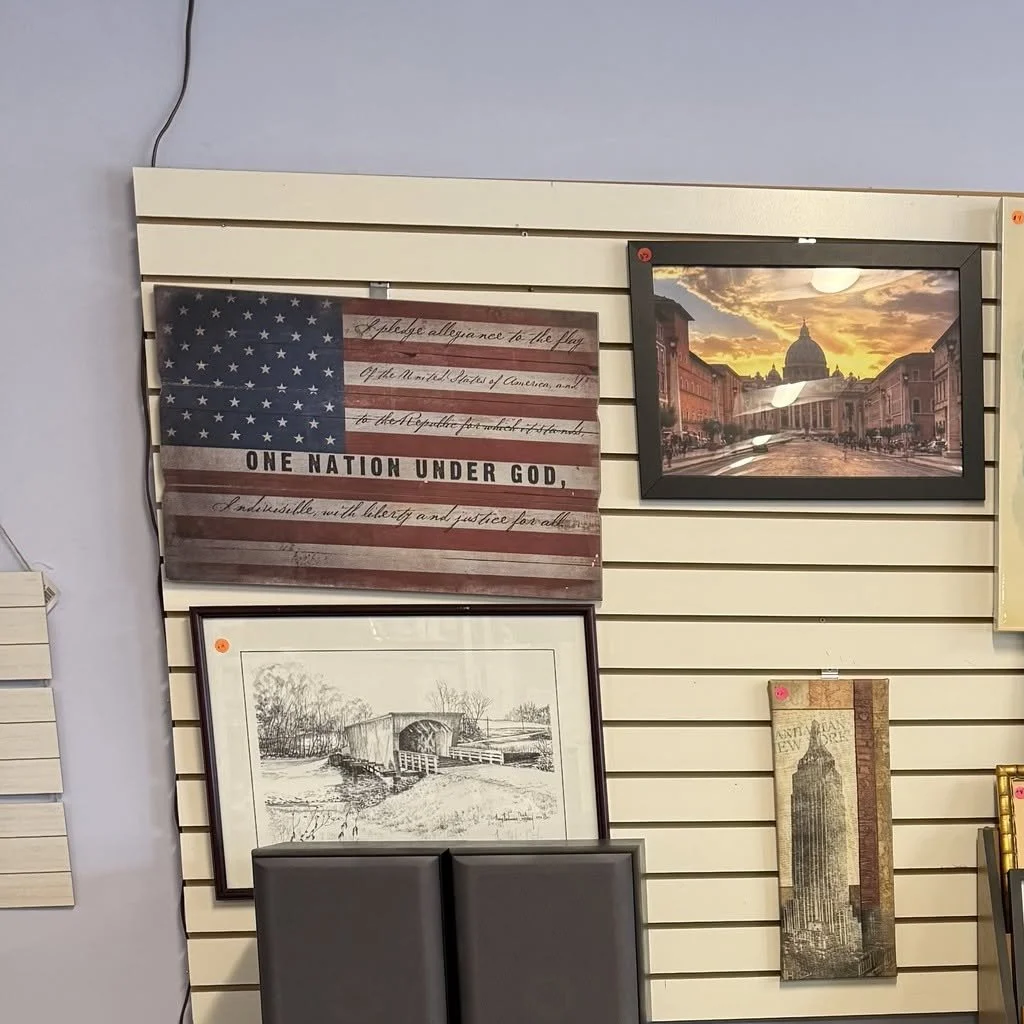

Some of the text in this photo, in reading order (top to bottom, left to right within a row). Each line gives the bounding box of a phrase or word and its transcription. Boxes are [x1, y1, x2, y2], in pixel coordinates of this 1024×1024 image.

[371, 317, 425, 344] pledge
[427, 321, 505, 348] allegiance
[509, 329, 525, 342] to
[528, 327, 552, 344] the
[551, 328, 584, 352] flag
[376, 368, 395, 380] the
[398, 368, 450, 383] United
[450, 369, 486, 385] States
[489, 374, 503, 390] of
[355, 411, 369, 425] to
[374, 411, 399, 427] the
[398, 411, 458, 431] Republic
[457, 417, 482, 436] for
[482, 419, 518, 433] which
[246, 450, 566, 490] ONE NATION UNDER GOD,
[211, 495, 318, 517] Indivisible,
[321, 502, 358, 519] with
[360, 501, 412, 529] liberty
[416, 504, 458, 524] and
[444, 509, 509, 533] justice
[506, 510, 537, 532] for
